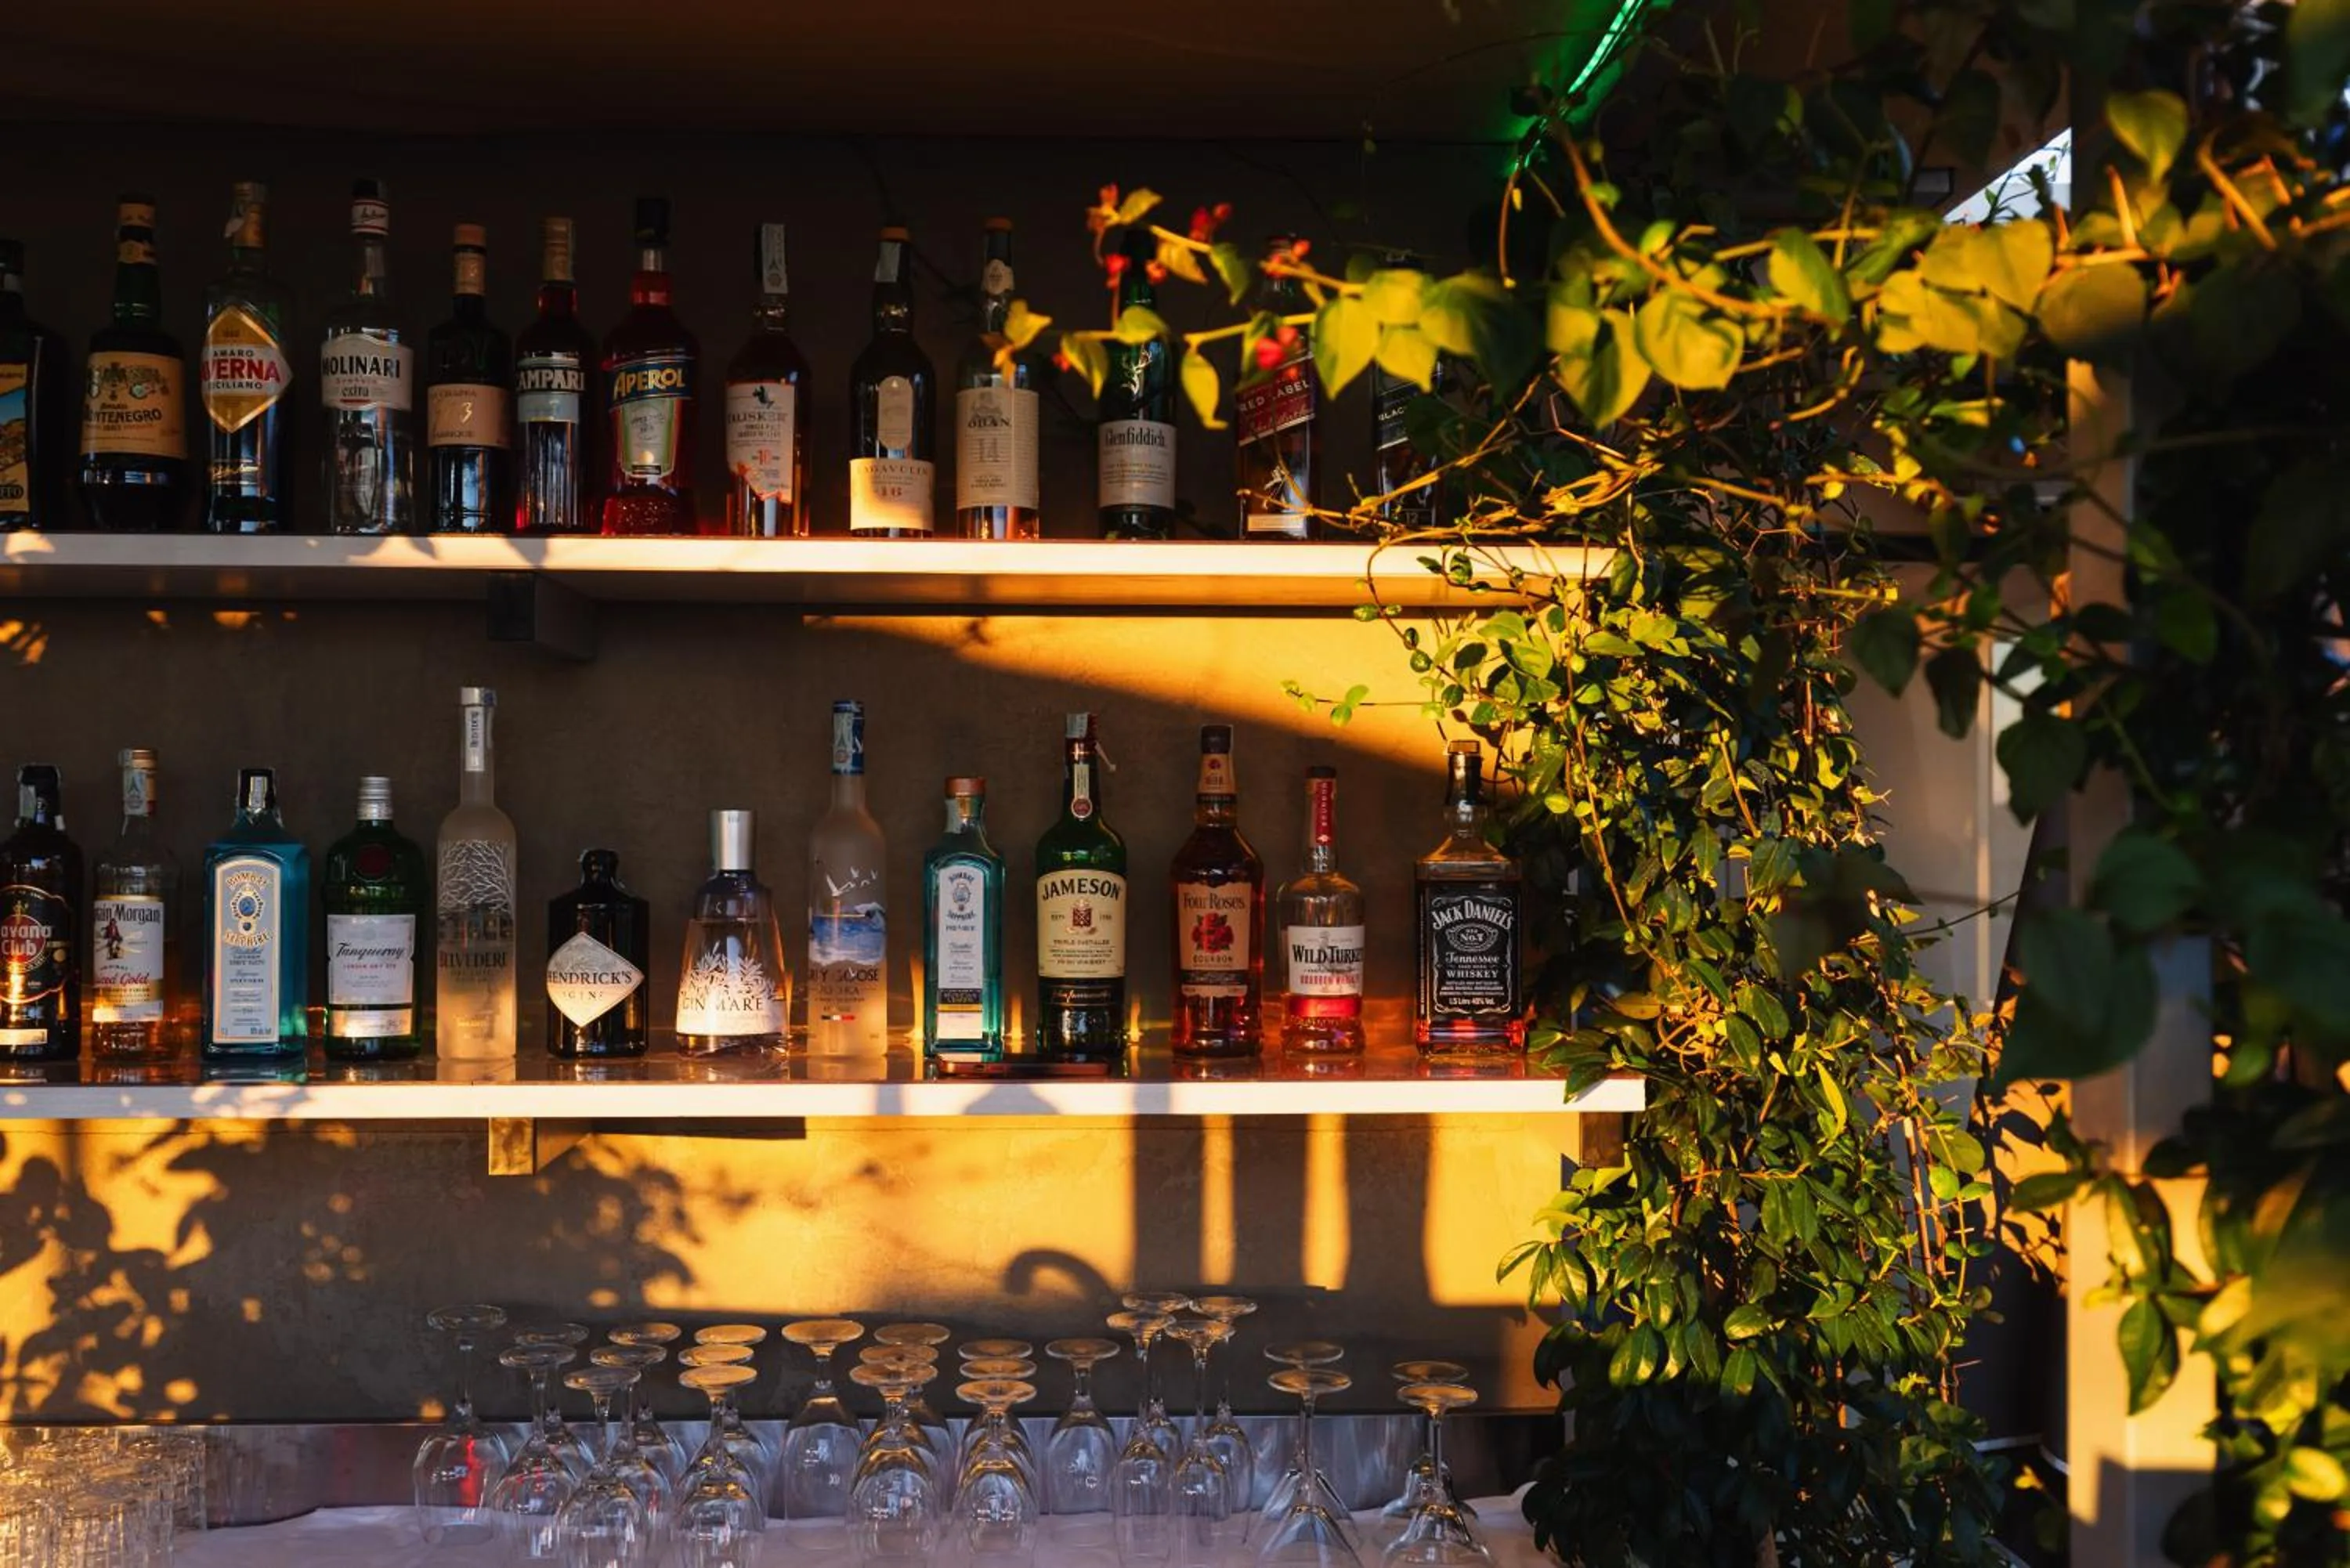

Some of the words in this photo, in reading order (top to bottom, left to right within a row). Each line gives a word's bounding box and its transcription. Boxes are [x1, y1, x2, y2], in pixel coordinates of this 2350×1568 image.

[214, 349, 254, 359] AMARO
[201, 359, 280, 383] AVERNA
[322, 356, 400, 378] MOLINARI
[515, 369, 585, 392] CAMPARI
[613, 368, 685, 400] APEROL
[1239, 395, 1266, 413] RED
[1274, 379, 1310, 399] ABEL
[461, 401, 473, 425] 3
[1378, 406, 1408, 421] BLAC
[967, 417, 1010, 428] OBAN
[859, 464, 928, 475] AGAVULIN
[1043, 878, 1121, 901] JAMESON
[114, 904, 161, 924] Morgan
[1432, 905, 1463, 930] JACK
[1463, 900, 1514, 930] DANIEL'S
[1, 925, 52, 939] avana
[1, 940, 37, 957] Club
[336, 941, 405, 961] Tanqueray
[1292, 945, 1328, 964] WILD
[439, 952, 508, 968] BELVEDERE
[1192, 955, 1233, 964] BOURBON
[1445, 952, 1500, 963] Tennessee
[120, 971, 150, 987] Gold
[548, 970, 632, 985] HENDRICK'S
[1446, 970, 1499, 978] WHISKEY
